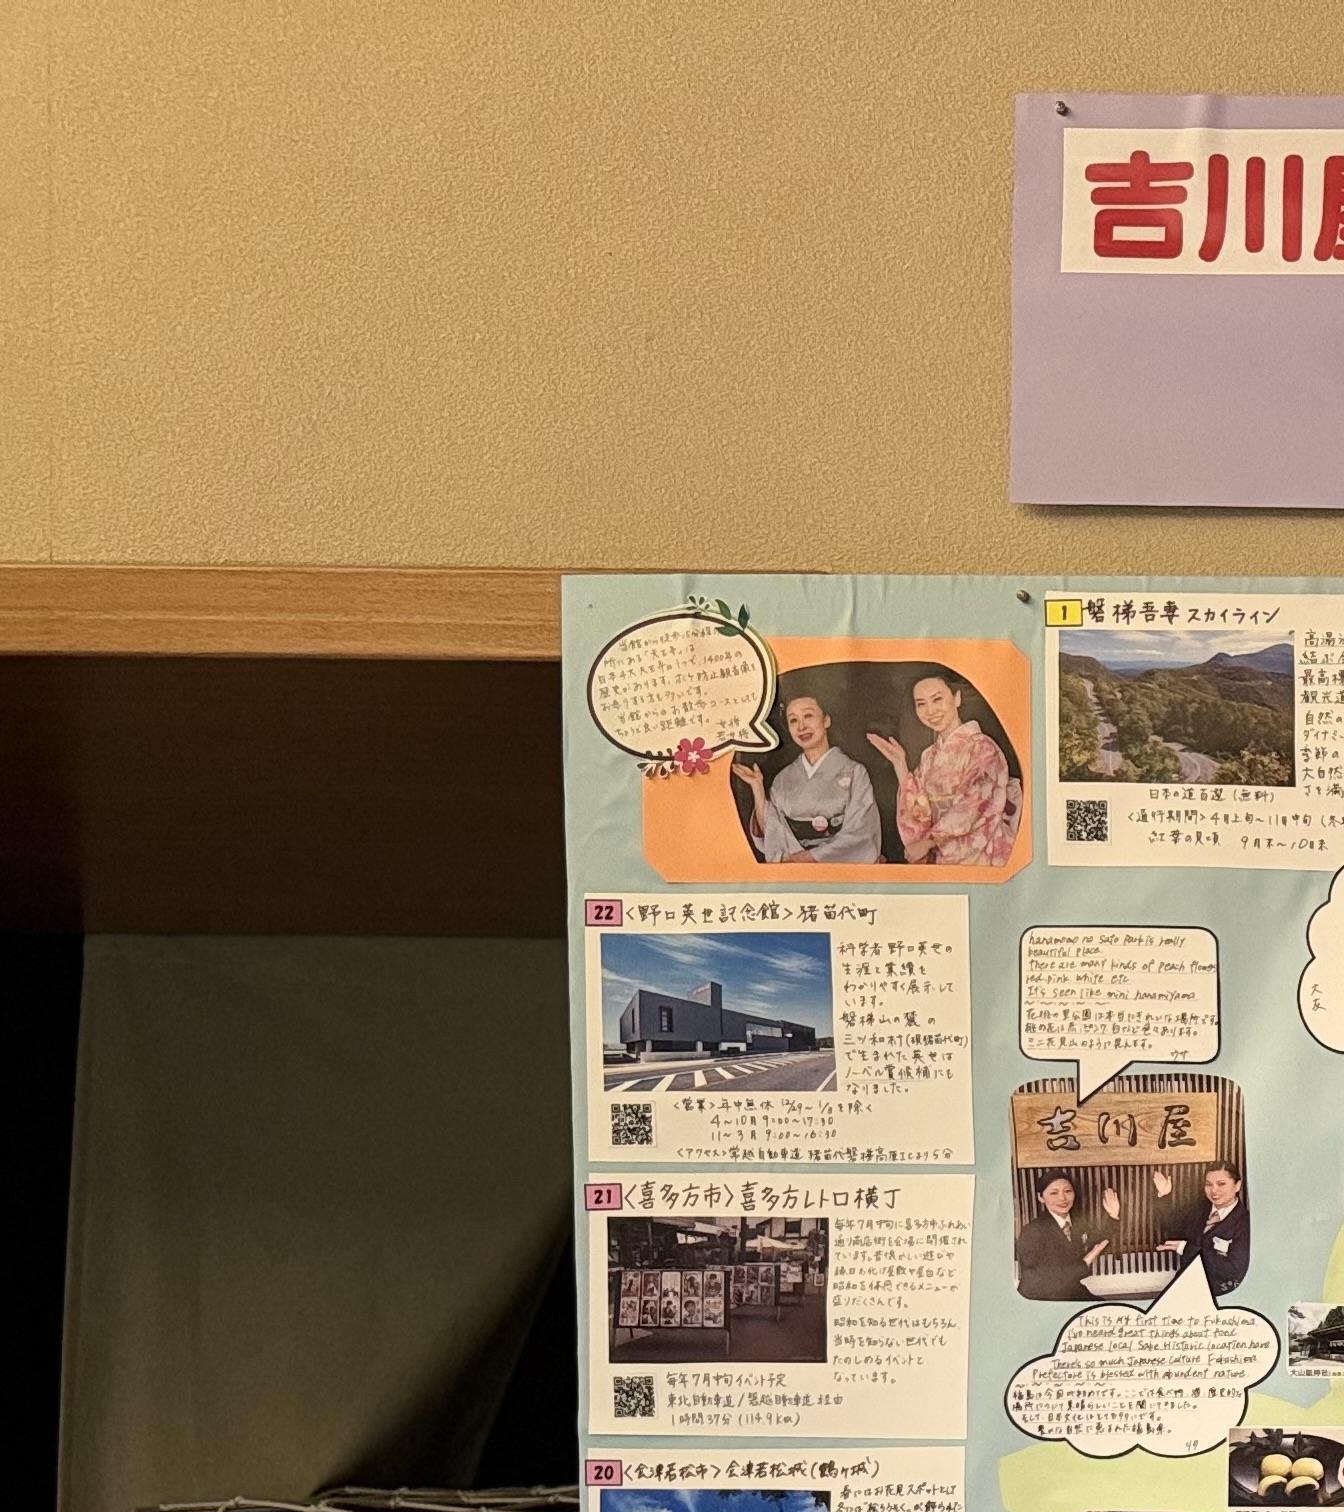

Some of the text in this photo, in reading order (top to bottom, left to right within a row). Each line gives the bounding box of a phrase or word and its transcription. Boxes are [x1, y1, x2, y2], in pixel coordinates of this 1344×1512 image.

[1061, 605, 1068, 621] 1
[1187, 606, 1281, 625] スカイライン
[594, 904, 614, 921] 22
[1036, 1104, 1198, 1153] 吉川屋
[594, 1189, 612, 1205] 21
[594, 1465, 614, 1481] 20
